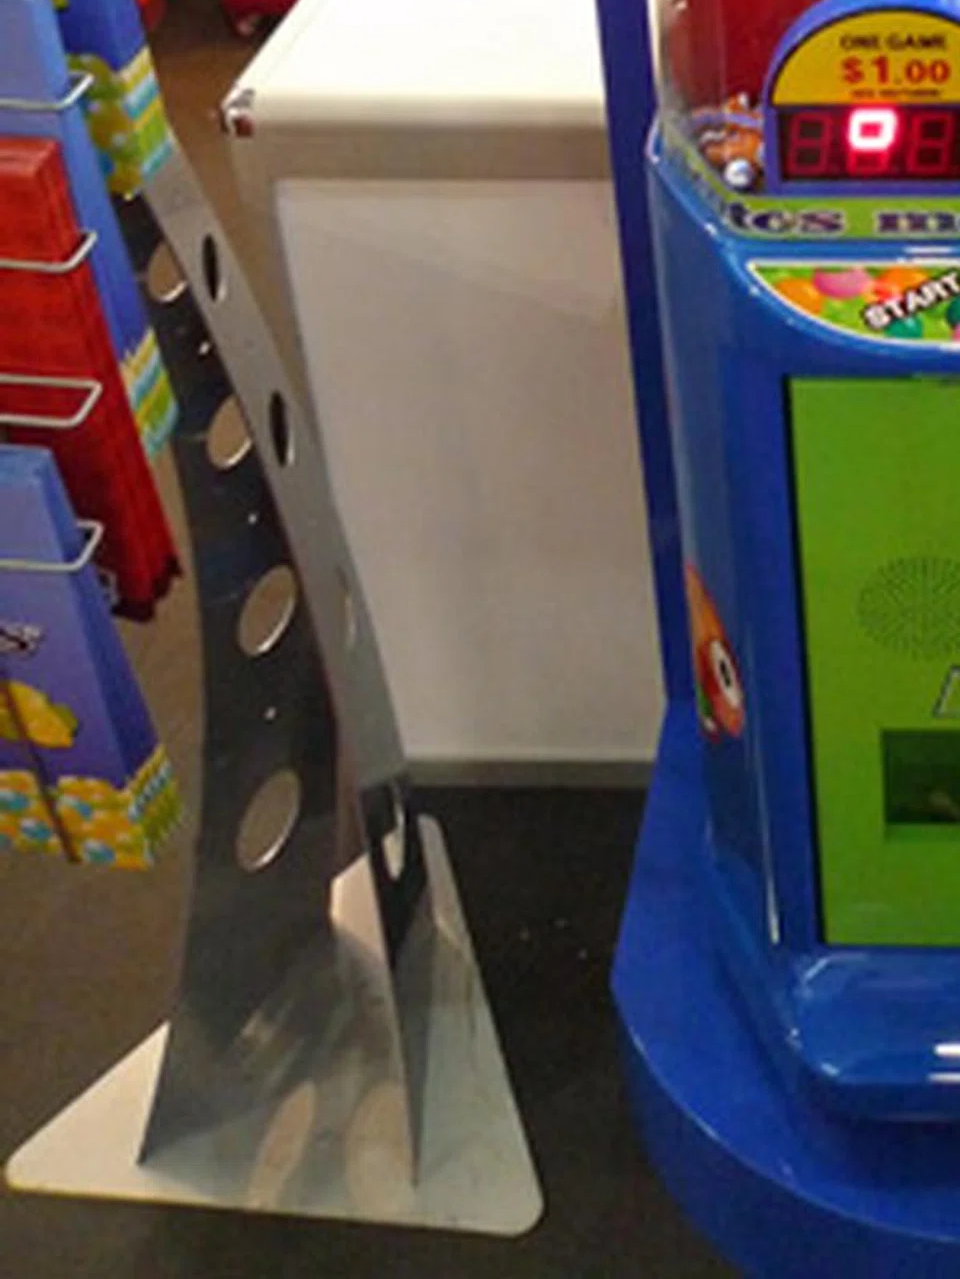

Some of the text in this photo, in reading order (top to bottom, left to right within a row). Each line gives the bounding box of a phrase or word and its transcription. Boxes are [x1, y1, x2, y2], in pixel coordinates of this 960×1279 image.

[840, 32, 947, 50] ONE GAME
[841, 54, 950, 84] $1.00
